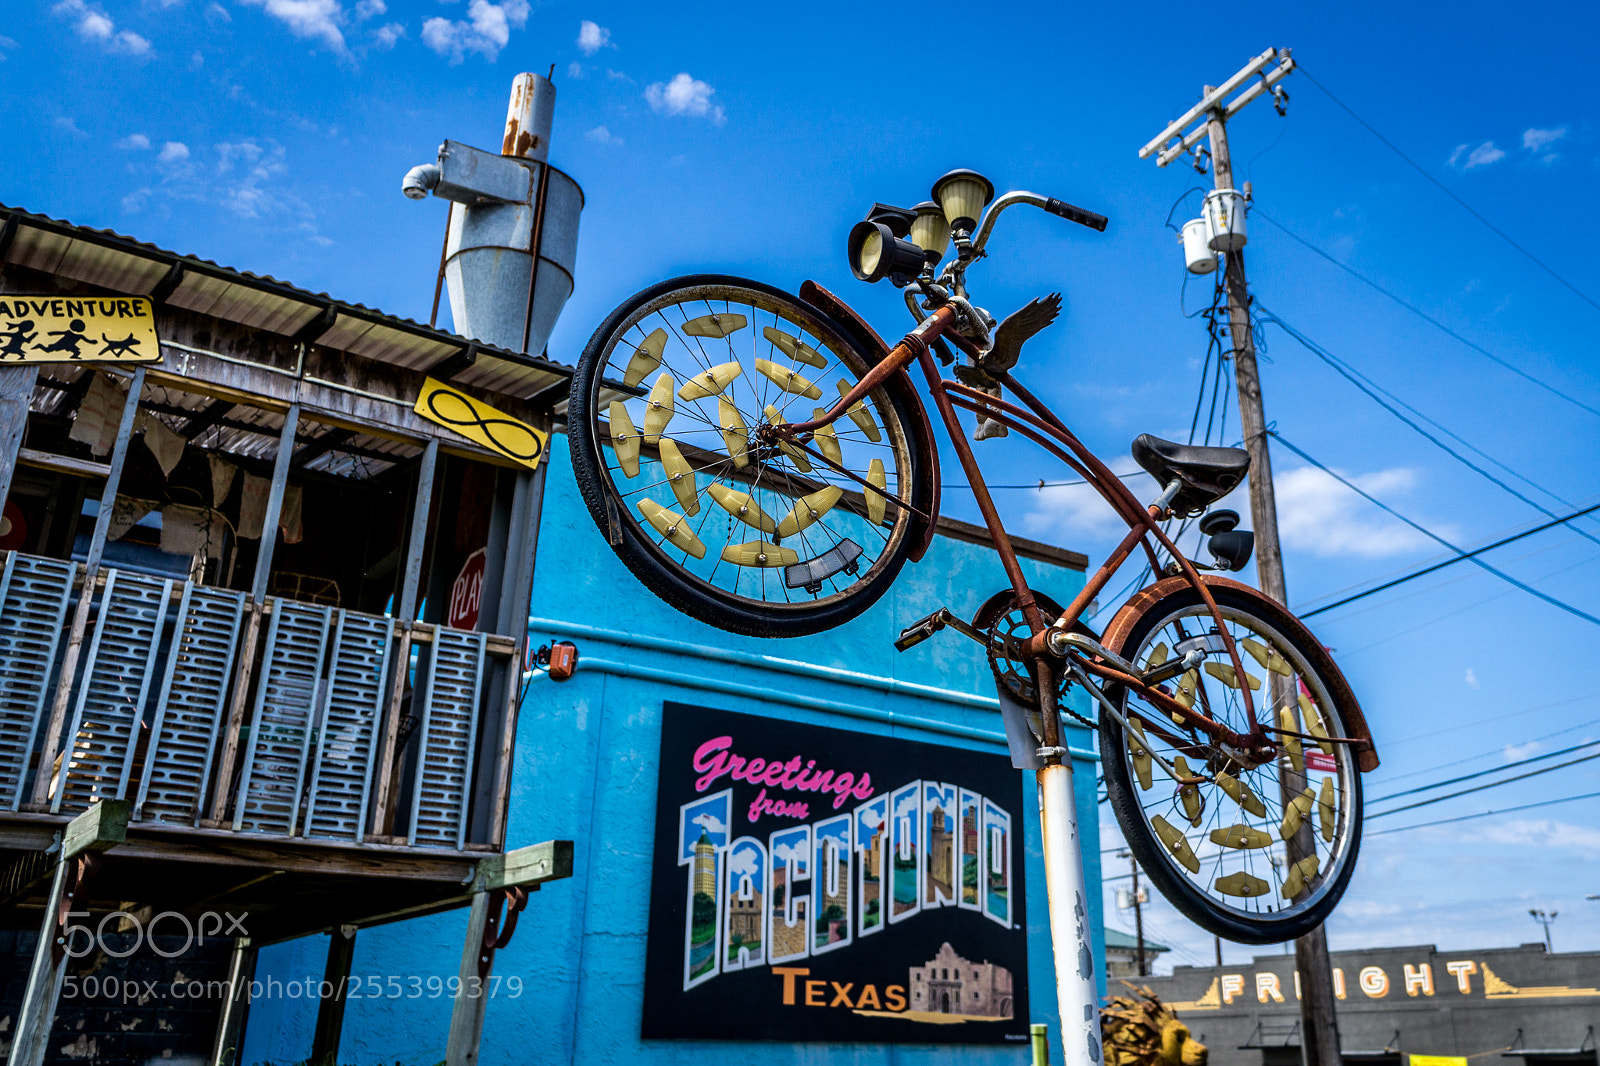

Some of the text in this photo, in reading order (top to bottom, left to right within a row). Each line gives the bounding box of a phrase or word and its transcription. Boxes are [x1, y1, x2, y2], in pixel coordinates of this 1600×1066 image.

[0, 299, 147, 319] ADVENTURE
[692, 735, 874, 809] Greetings
[747, 788, 810, 822] from
[1220, 960, 1478, 1005] FRIGHT
